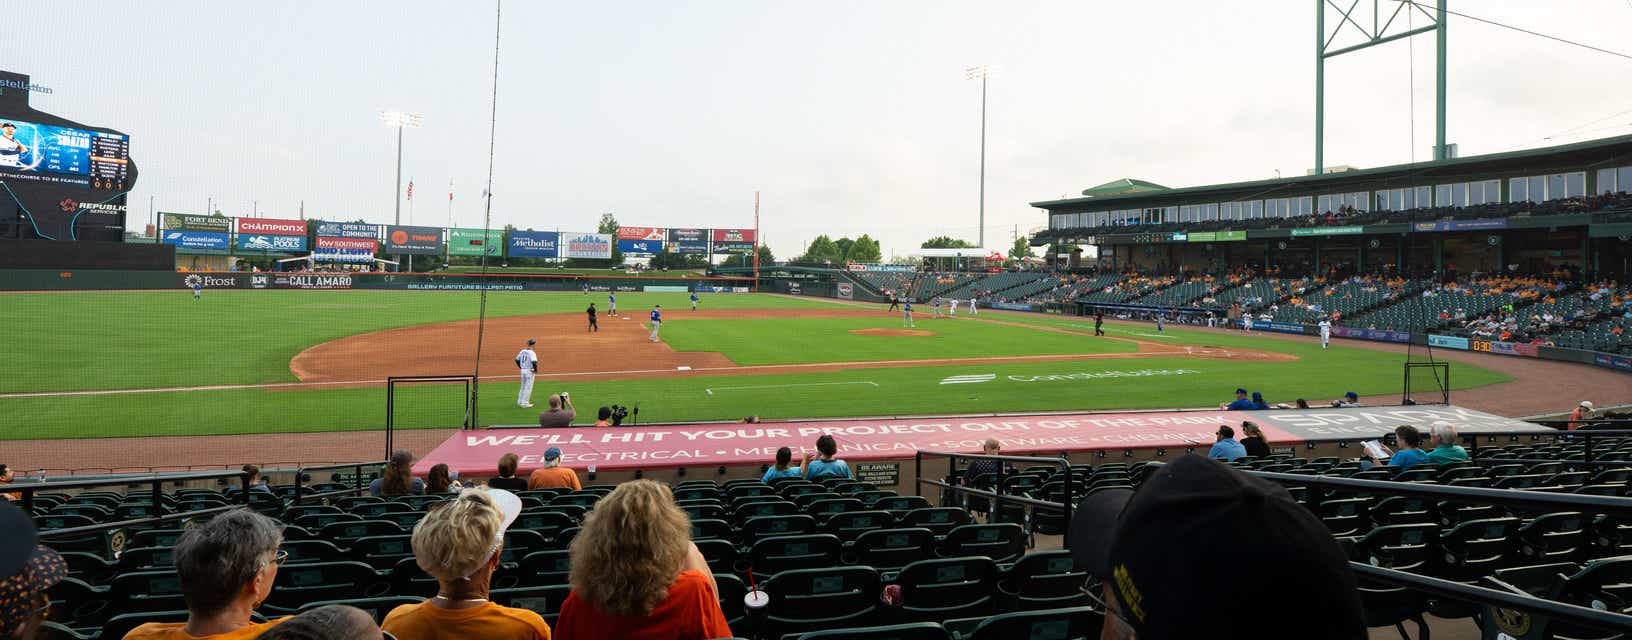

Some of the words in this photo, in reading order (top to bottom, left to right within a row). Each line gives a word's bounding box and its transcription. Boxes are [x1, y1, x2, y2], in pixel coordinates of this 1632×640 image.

[79, 202, 128, 212] REPUBLIC
[342, 231, 377, 239] COMMUNITY
[334, 240, 375, 248] SOUTHWEST
[513, 239, 555, 248] Methodist
[204, 276, 236, 286] Frost
[290, 276, 313, 286] CALL
[315, 276, 352, 287] AMARO
[1008, 369, 1201, 381] Constellation
[466, 433, 593, 448] WE'LL
[598, 431, 674, 446] HIT
[679, 428, 793, 443] YOUR
[798, 424, 956, 438] PROJECT
[960, 421, 1032, 433] OUT
[1037, 420, 1083, 430] OF
[1087, 417, 1149, 429] THE
[1150, 415, 1234, 426] PARK
[519, 449, 709, 465] EECTRICAL
[734, 441, 921, 457] MEHNICAL
